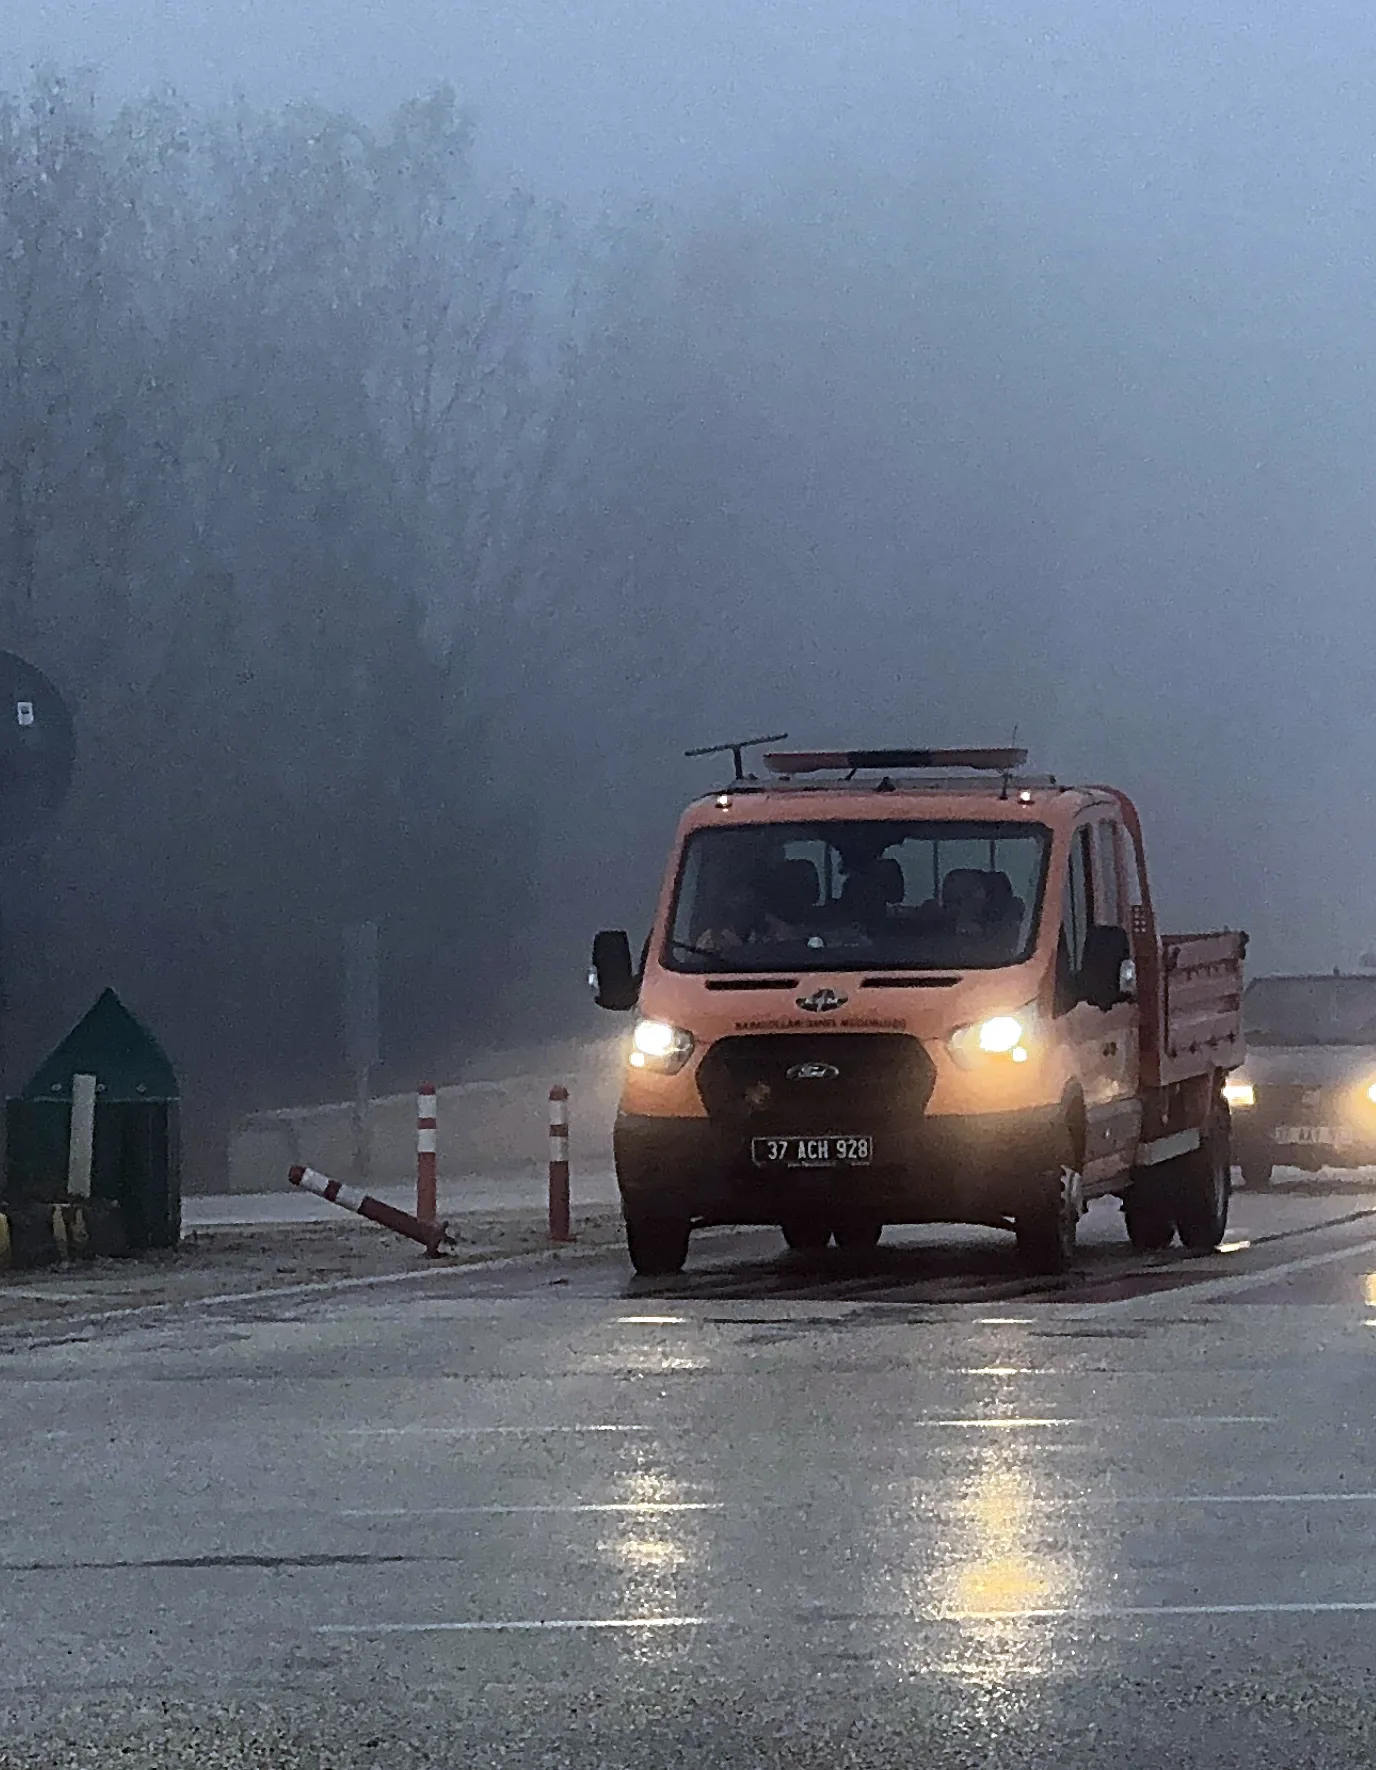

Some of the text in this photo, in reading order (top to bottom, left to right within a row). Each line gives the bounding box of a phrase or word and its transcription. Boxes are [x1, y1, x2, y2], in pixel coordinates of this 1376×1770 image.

[767, 1139, 868, 1160] 37 ACH 928
